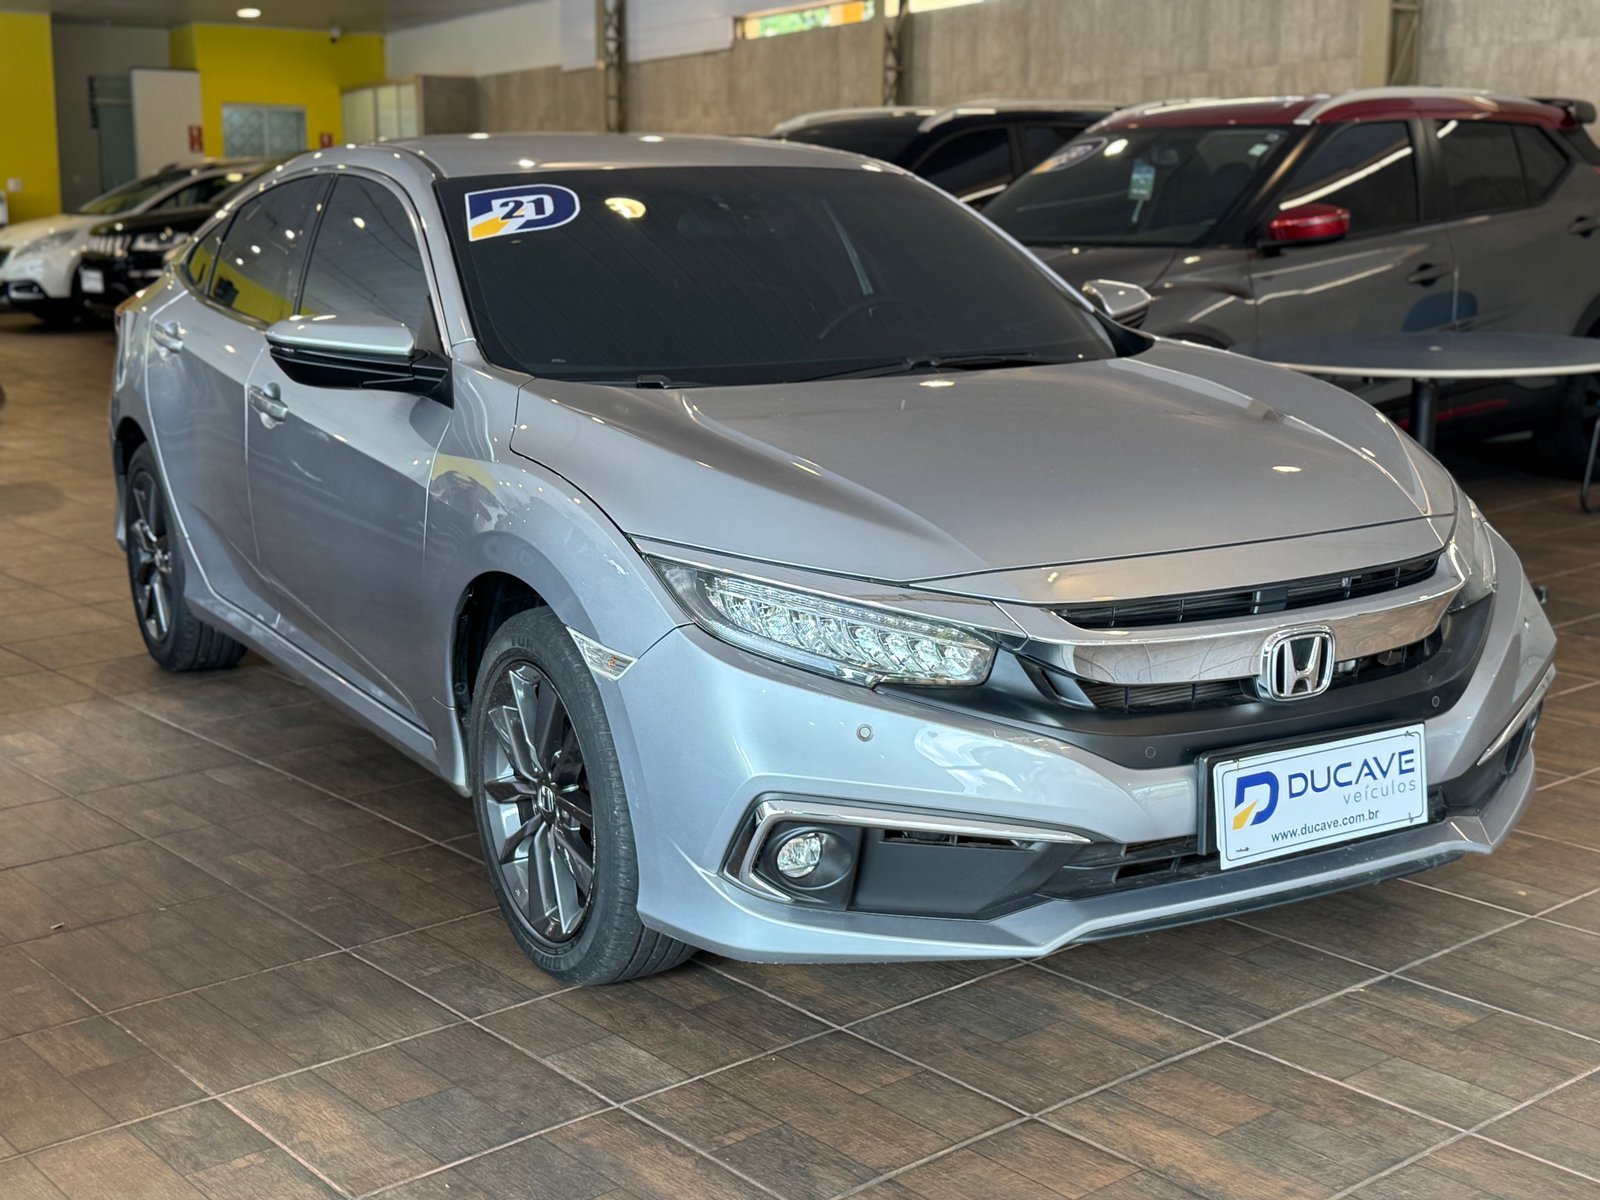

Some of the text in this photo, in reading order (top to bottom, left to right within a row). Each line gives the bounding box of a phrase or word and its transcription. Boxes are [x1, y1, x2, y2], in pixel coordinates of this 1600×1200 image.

[499, 197, 546, 221] 21
[1288, 749, 1415, 799] DUCAVE
[1343, 779, 1417, 805] veículos
[1271, 809, 1380, 843] www.ducave.com.br
